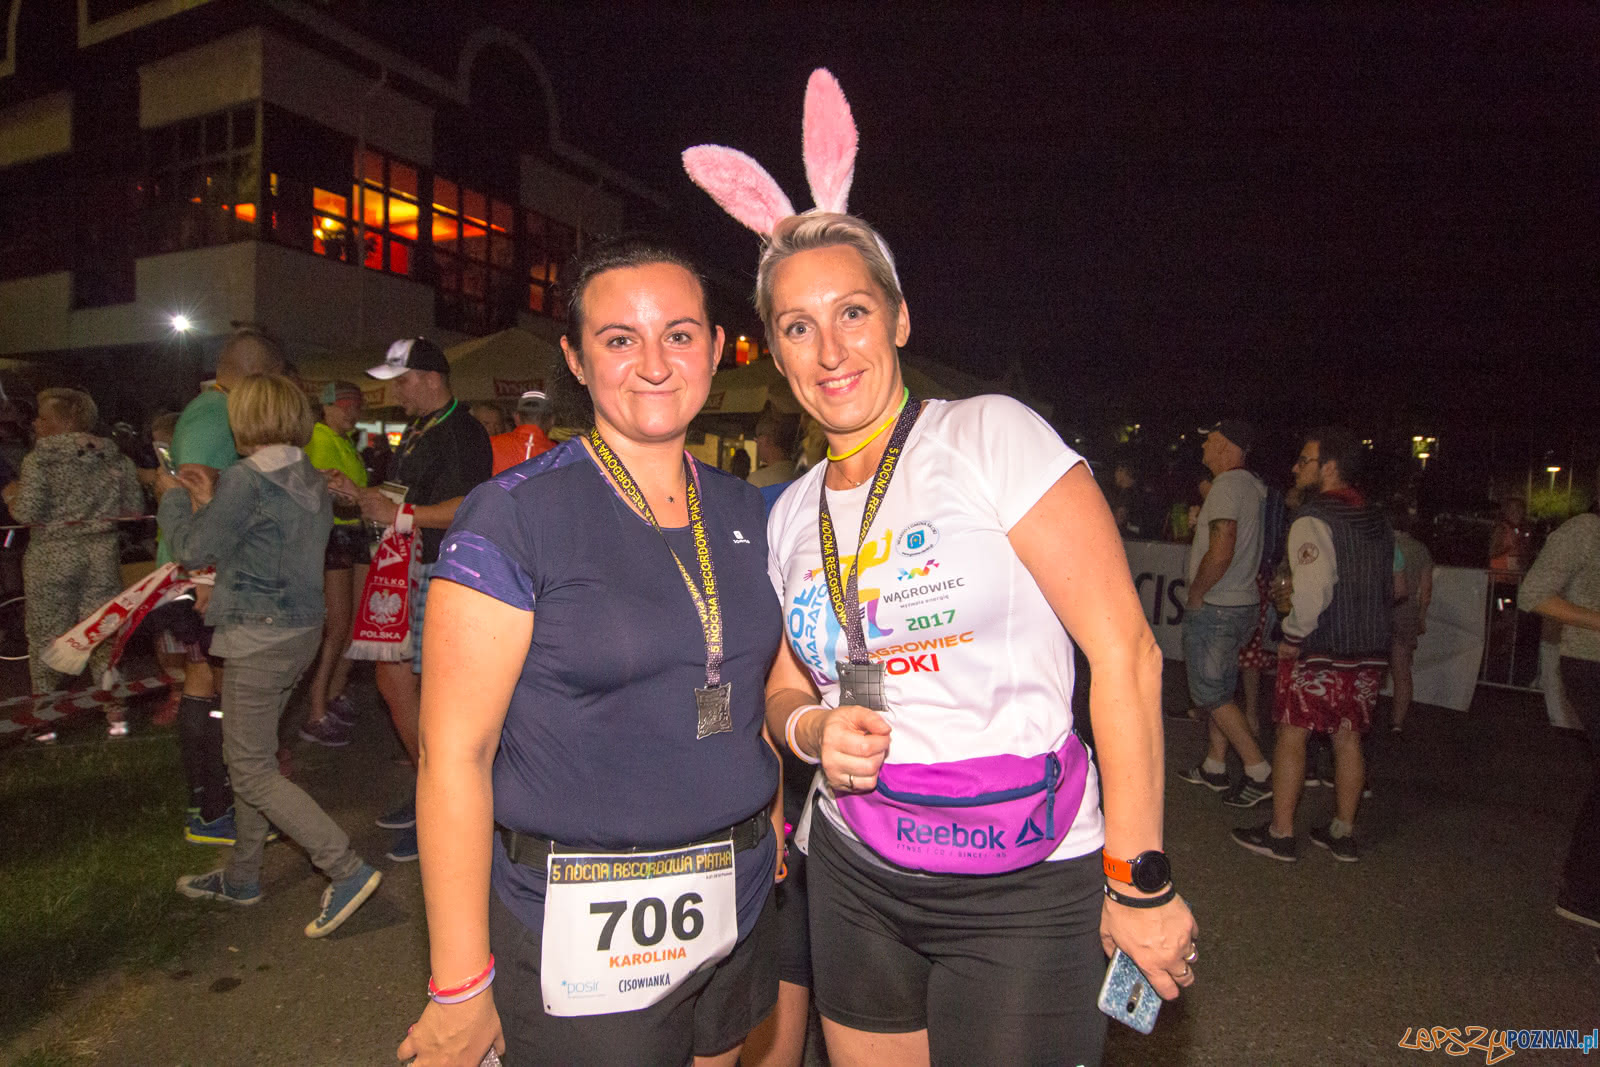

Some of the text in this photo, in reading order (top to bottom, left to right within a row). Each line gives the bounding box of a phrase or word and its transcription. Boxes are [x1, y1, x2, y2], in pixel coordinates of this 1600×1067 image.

[889, 447, 899, 455] 5
[599, 443, 645, 511] RECORDOWA
[873, 455, 896, 495] NOCNA
[822, 520, 834, 555] NOCNA
[694, 521, 716, 595] RECORDOWA
[373, 576, 406, 586] TYLKO
[825, 556, 848, 629] RECORDOW
[883, 577, 966, 604] WĄGROWIEC
[708, 597, 720, 642] NOCNA
[804, 577, 829, 671] MARATO
[905, 609, 956, 632] 2017
[360, 630, 401, 640] POLSKA
[711, 645, 720, 653] 5
[877, 653, 940, 677] OKI
[897, 816, 1006, 850] Reebok
[552, 864, 561, 881] 5
[564, 863, 609, 881] NOCNA
[613, 855, 693, 880] RECORDOWA
[589, 892, 705, 952] 706
[608, 947, 687, 969] KAROLINA
[618, 973, 671, 993] CISOWIANKA
